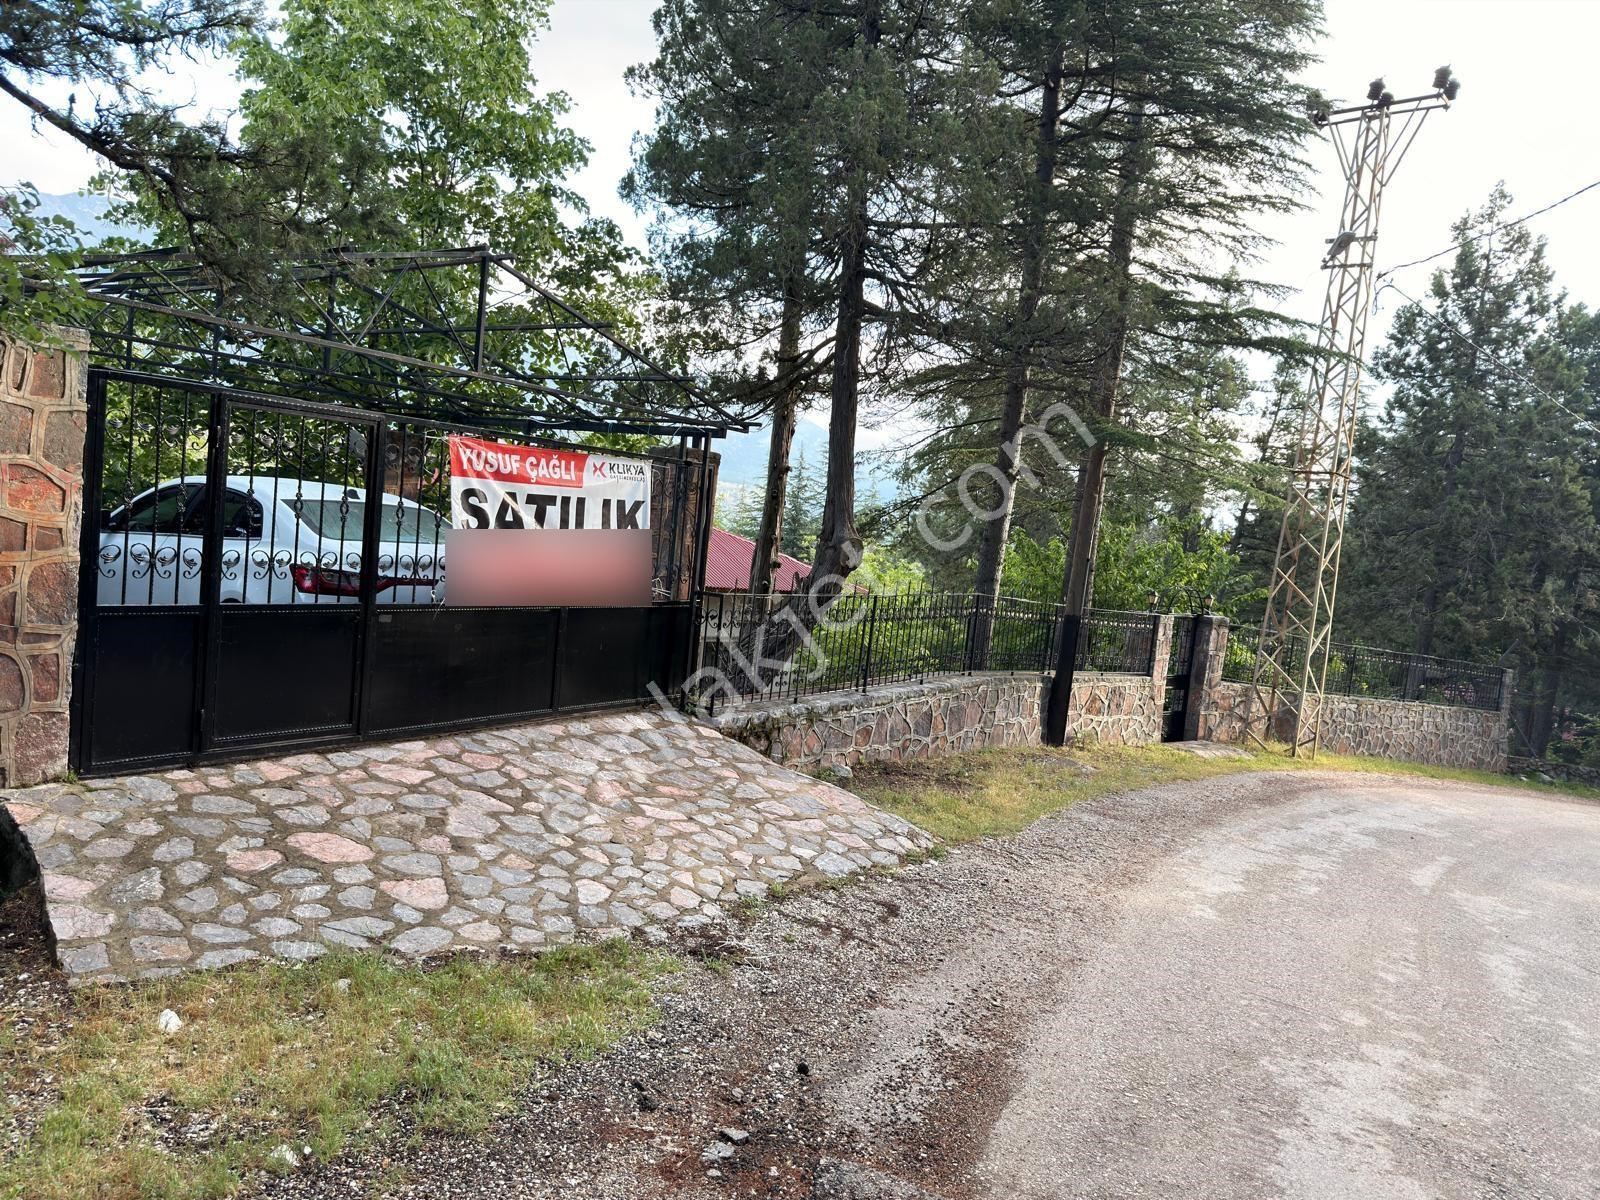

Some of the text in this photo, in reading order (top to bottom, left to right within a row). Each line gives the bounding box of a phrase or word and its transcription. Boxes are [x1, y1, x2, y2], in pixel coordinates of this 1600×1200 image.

[458, 447, 576, 483] YUSUF ÇAĞLI
[609, 463, 645, 476] KLIKYA
